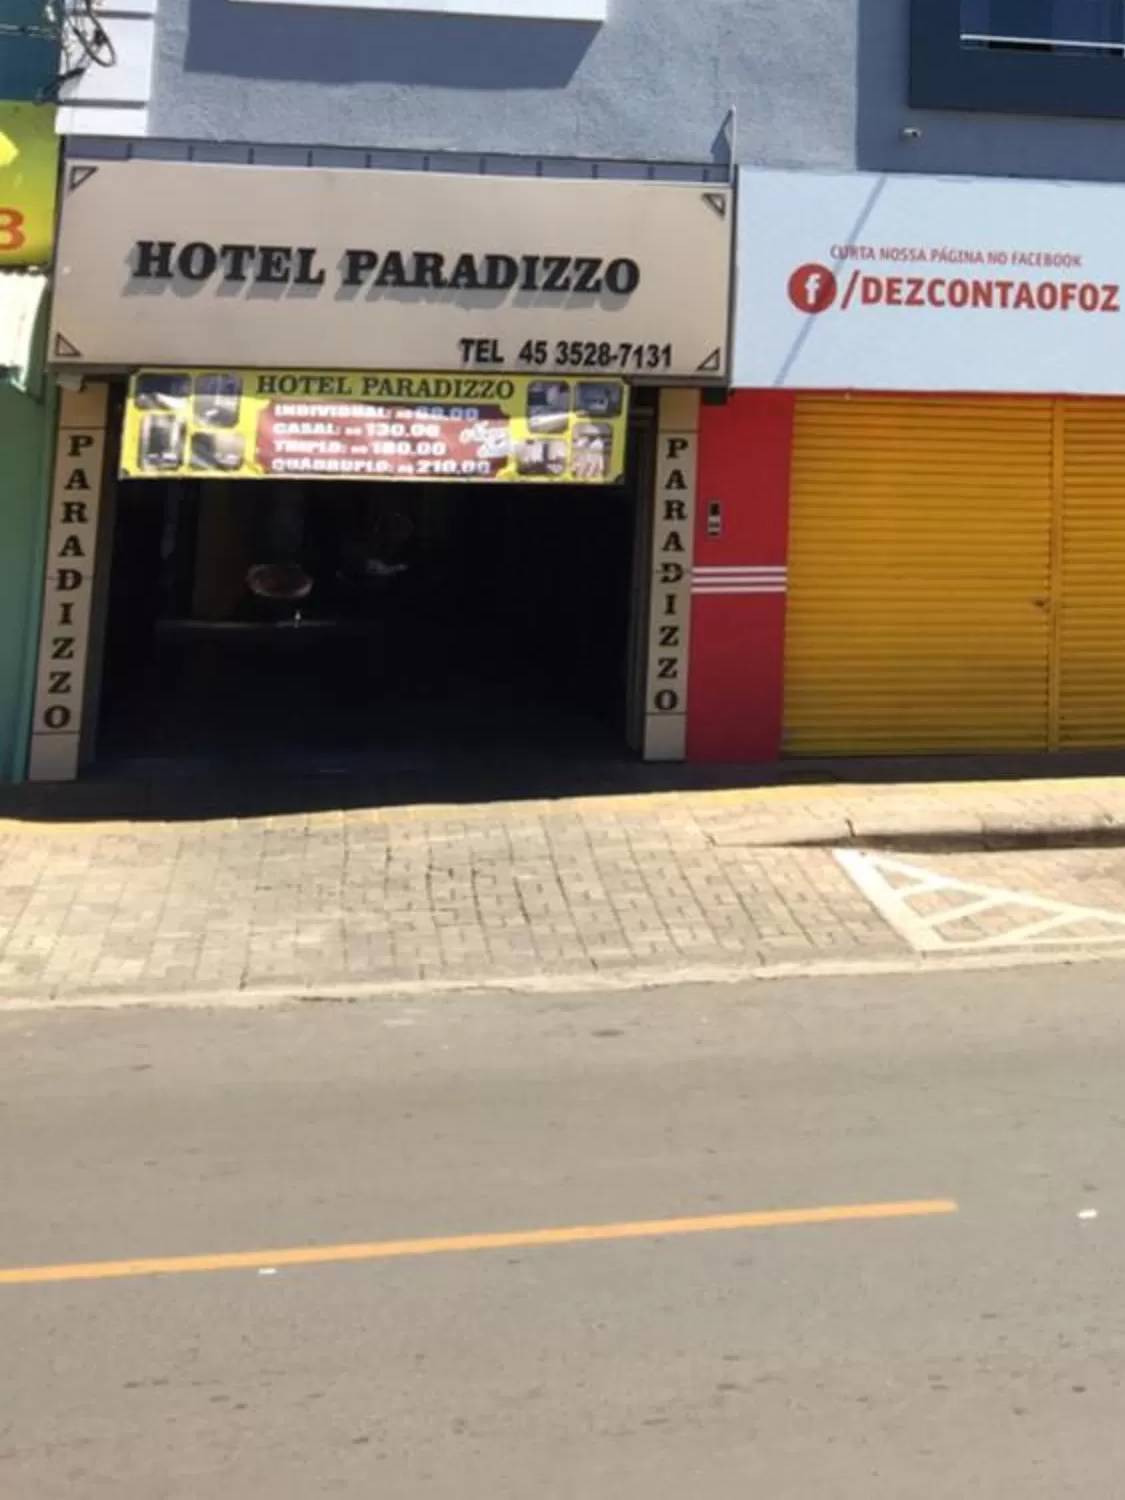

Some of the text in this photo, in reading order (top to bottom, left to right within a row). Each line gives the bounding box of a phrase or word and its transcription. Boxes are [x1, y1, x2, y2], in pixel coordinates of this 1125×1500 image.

[133, 241, 640, 296] HOTEL PARADIZZO
[830, 244, 1083, 268] CURTA NOSSA PÁGINA NO FACEBOOK
[840, 269, 1121, 313] /DEZCONTAOFOZ
[459, 338, 672, 369] TEL 45 3528-7131
[256, 375, 515, 399] HOTEL PARADIZZO
[43, 434, 94, 729] PARADIZZO
[653, 437, 689, 713] PARADIZZO
